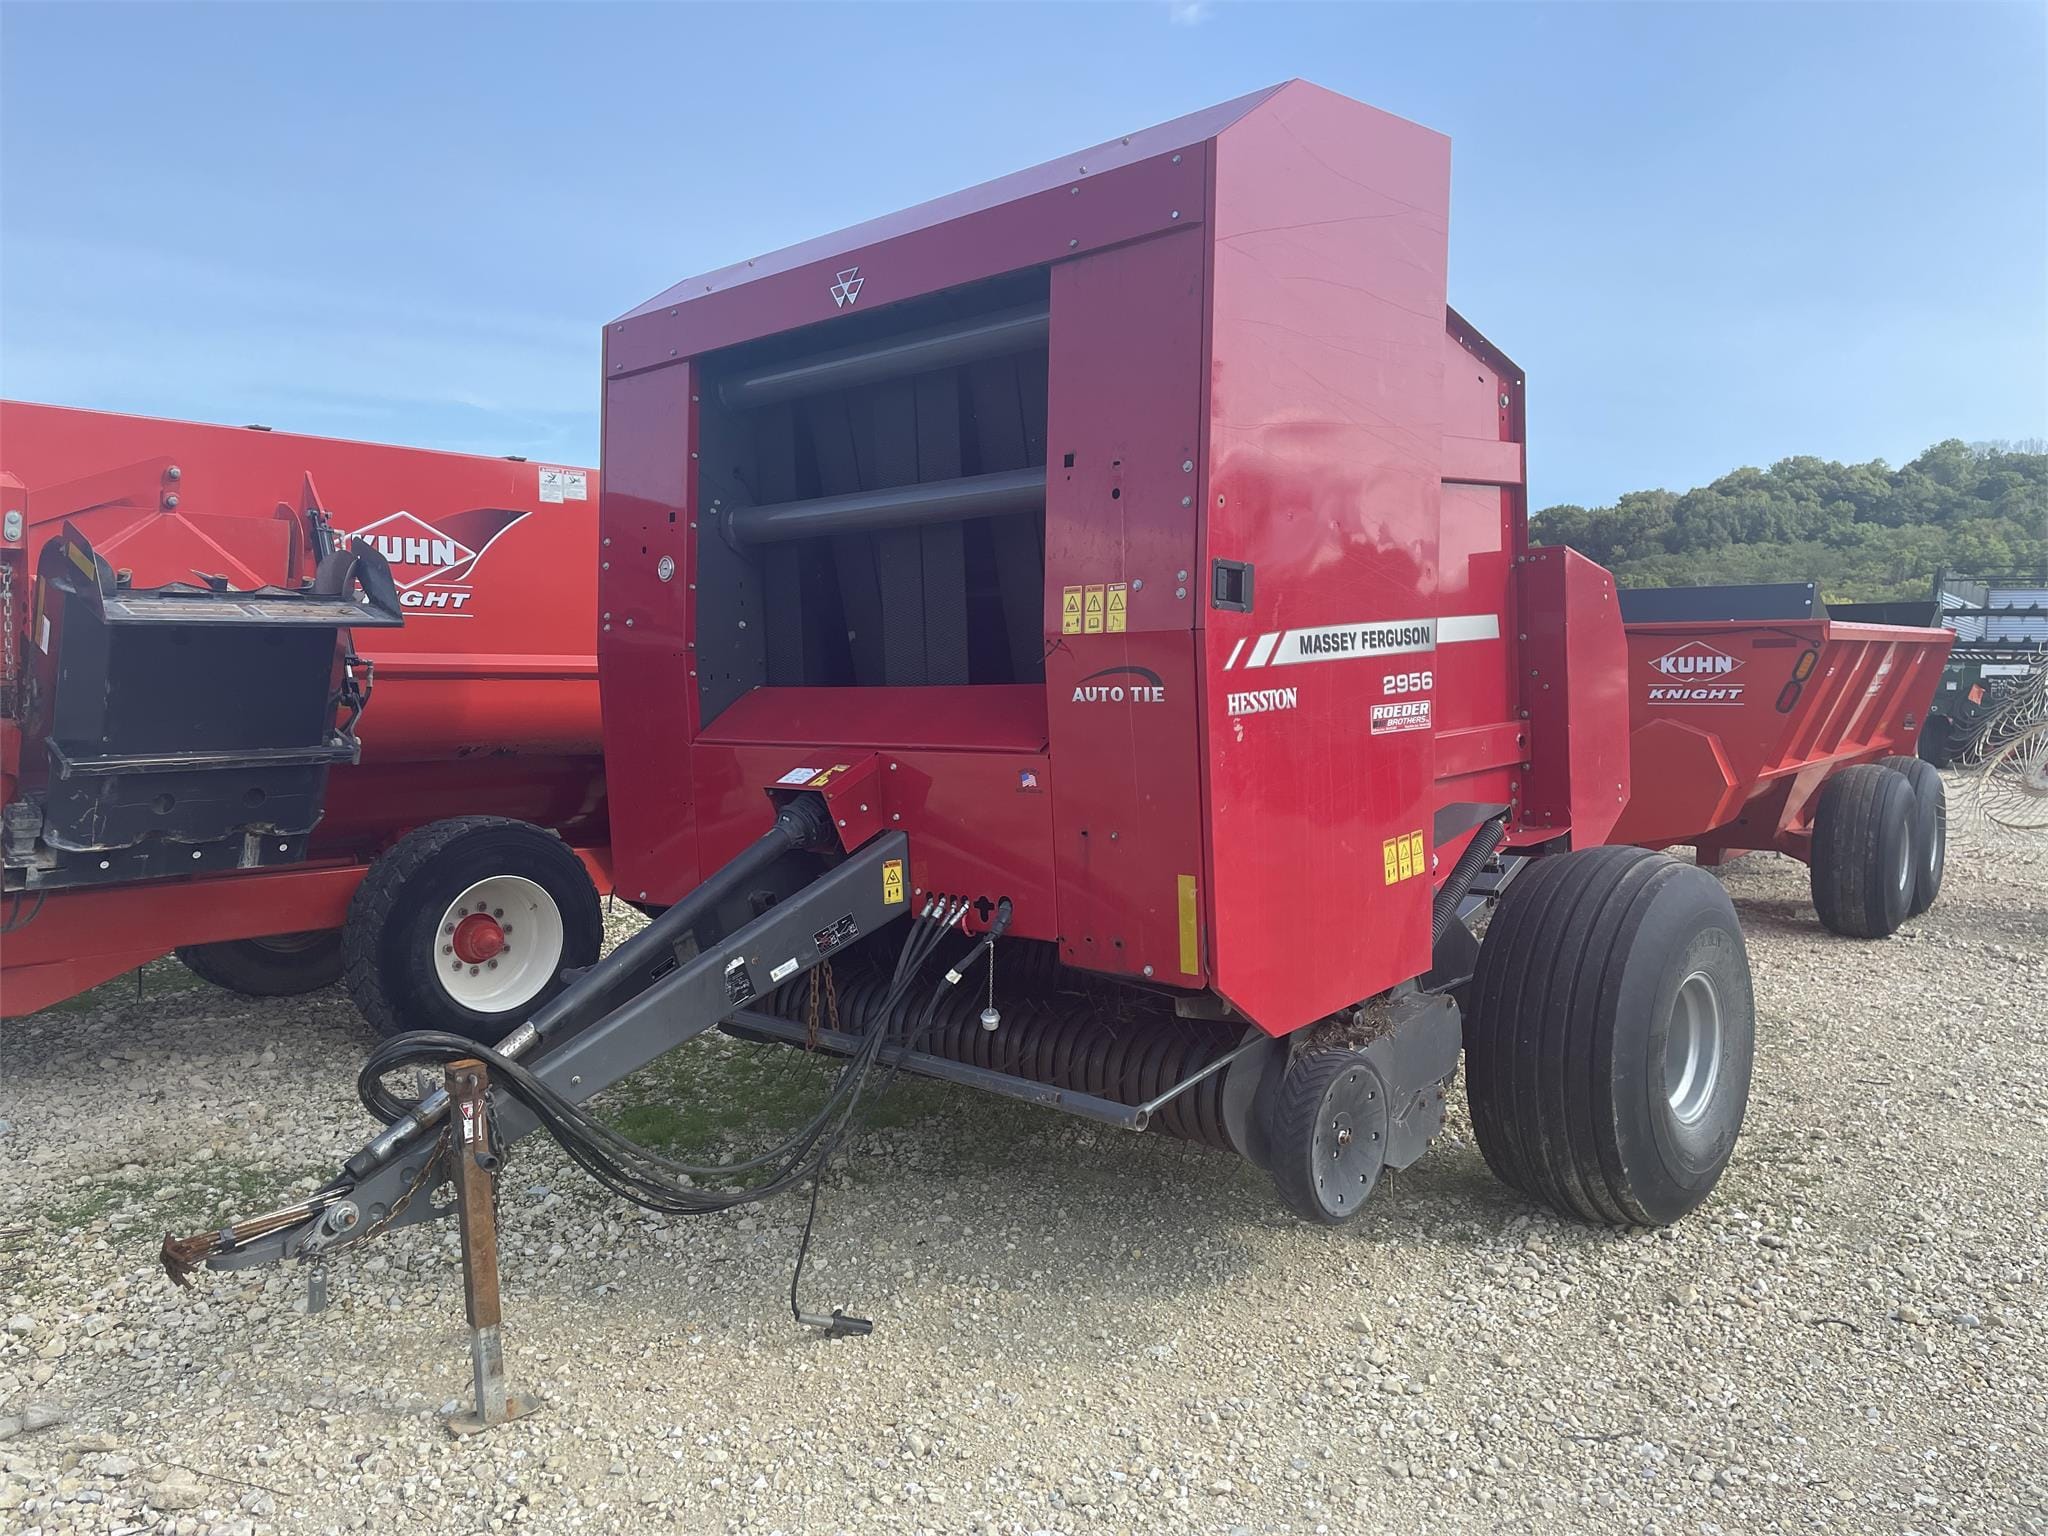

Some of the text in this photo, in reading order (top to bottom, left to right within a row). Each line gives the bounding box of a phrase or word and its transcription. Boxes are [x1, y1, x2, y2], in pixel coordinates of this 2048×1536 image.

[1300, 626, 1430, 655] MASSEY FERGUSON
[1660, 655, 1732, 673] KUHN
[1383, 671, 1433, 695] 2956
[1072, 686, 1165, 703] AUTO TIE
[1227, 687, 1297, 716] HESSTON
[1649, 689, 1743, 699] KNIGHT
[1373, 702, 1429, 720] ROEDER
[1387, 715, 1426, 727] BROTHERS
